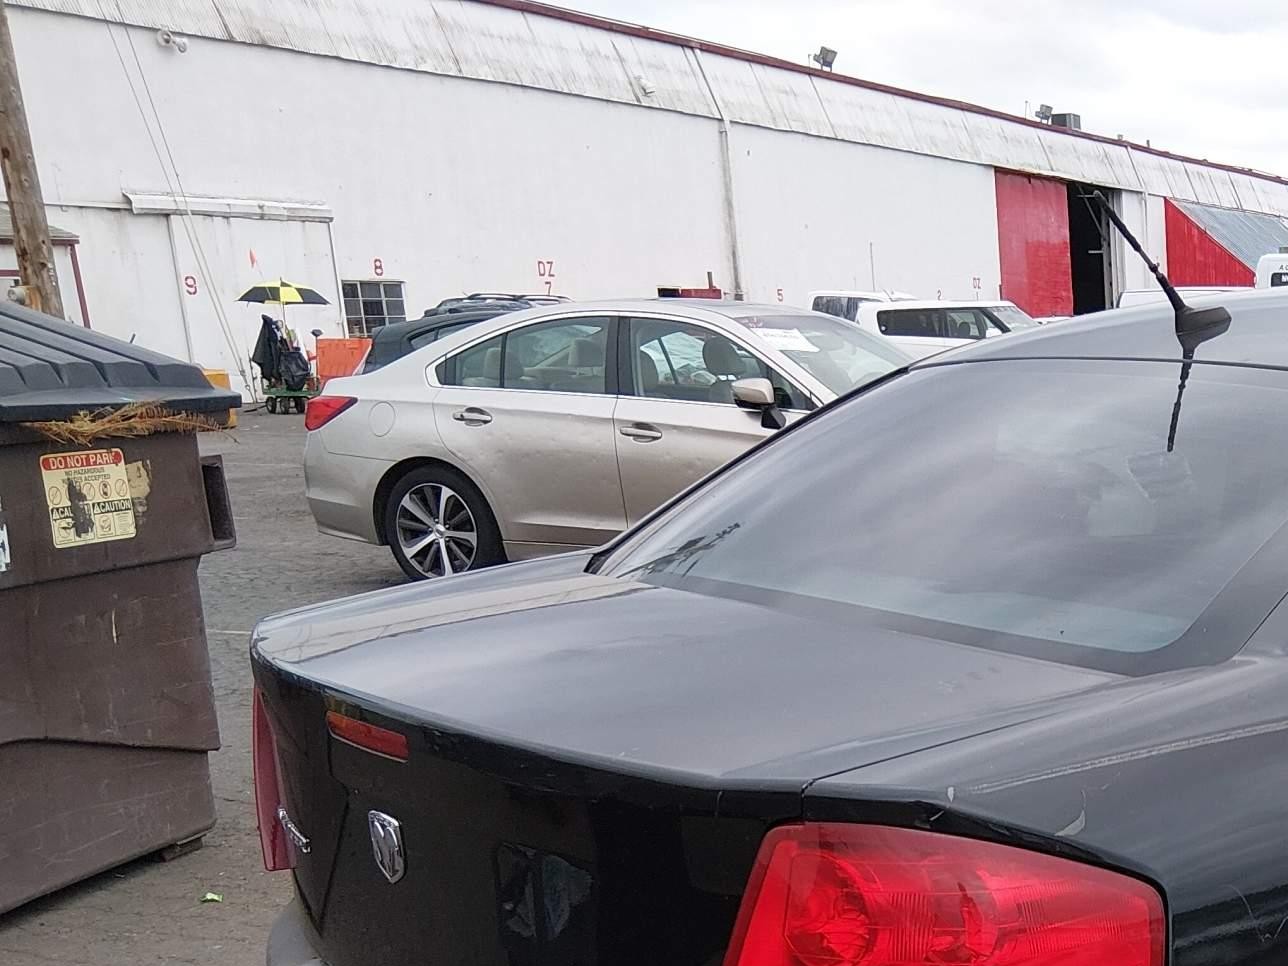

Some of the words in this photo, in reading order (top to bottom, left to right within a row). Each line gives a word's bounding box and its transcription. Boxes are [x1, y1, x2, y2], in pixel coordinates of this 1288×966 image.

[373, 258, 384, 277] 8
[184, 275, 198, 295] 9
[544, 281, 552, 296] 7
[776, 288, 784, 302] 5
[49, 457, 65, 470] DO
[66, 454, 88, 468] NOT
[100, 499, 131, 512] CAUTION
